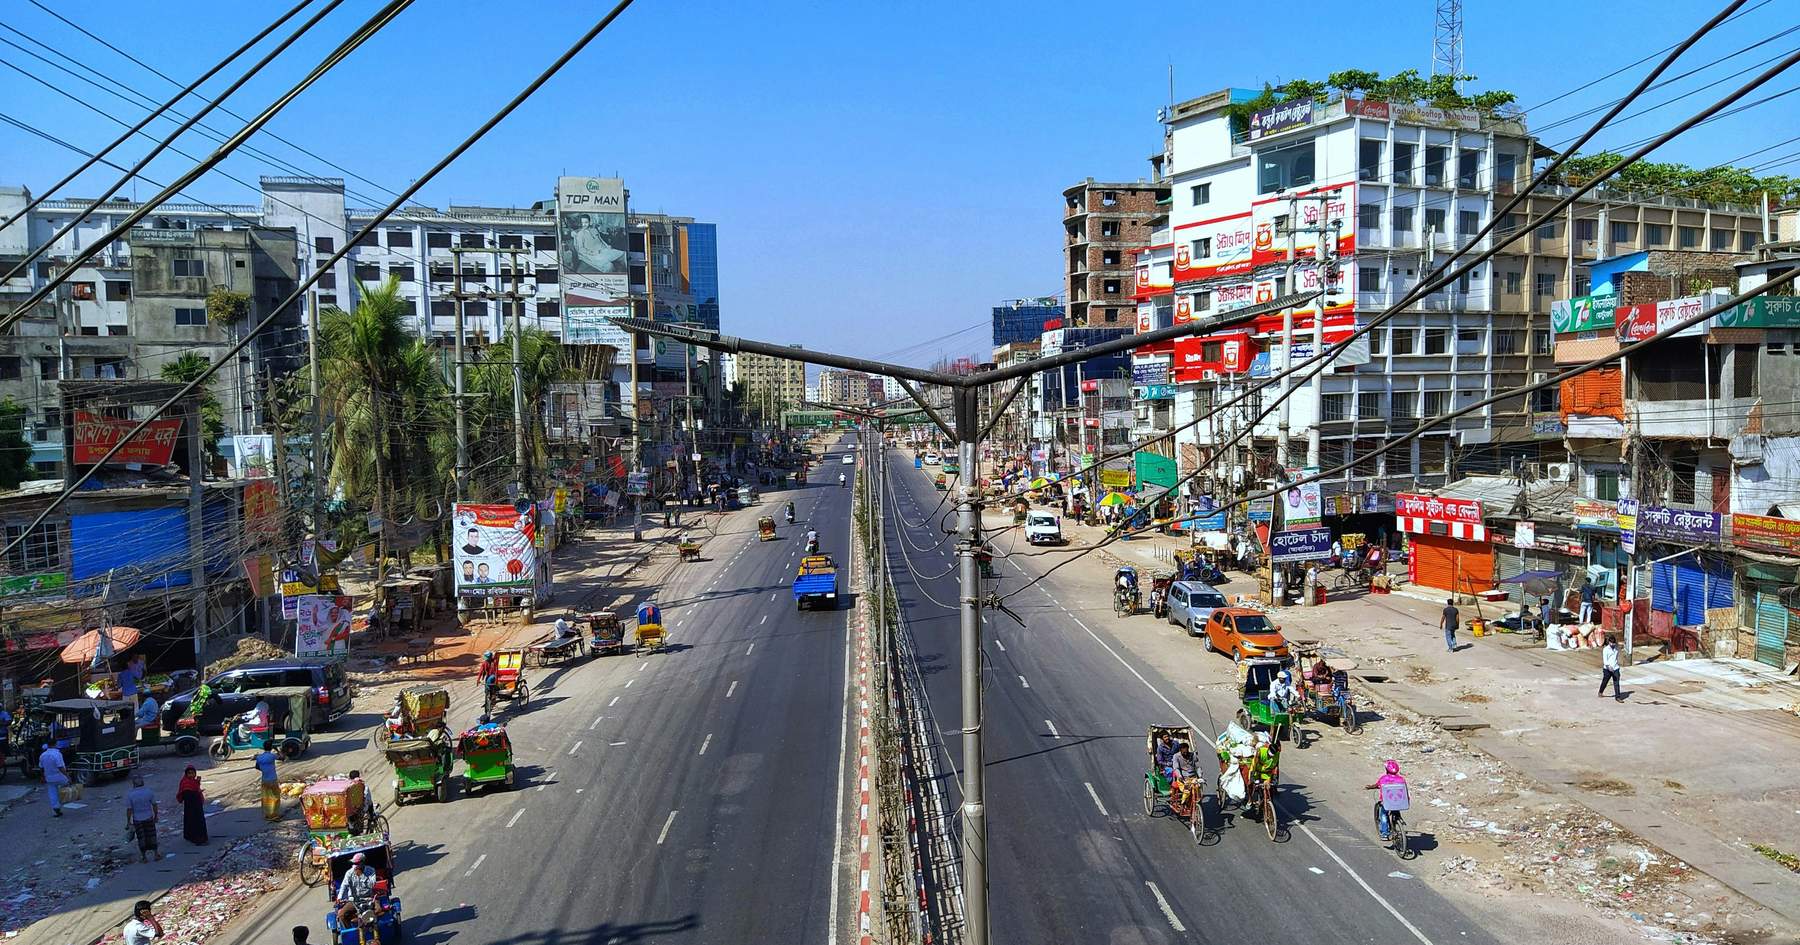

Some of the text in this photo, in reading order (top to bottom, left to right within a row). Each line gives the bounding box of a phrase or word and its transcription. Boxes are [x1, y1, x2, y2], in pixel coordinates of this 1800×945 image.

[1391, 106, 1416, 116] Kasturi
[1443, 110, 1478, 121] Restaurant
[566, 194, 619, 206] TOP MAN
[1272, 529, 1329, 547] হোটেল চাঁদ
[1288, 544, 1316, 555] (আবাসিক)
